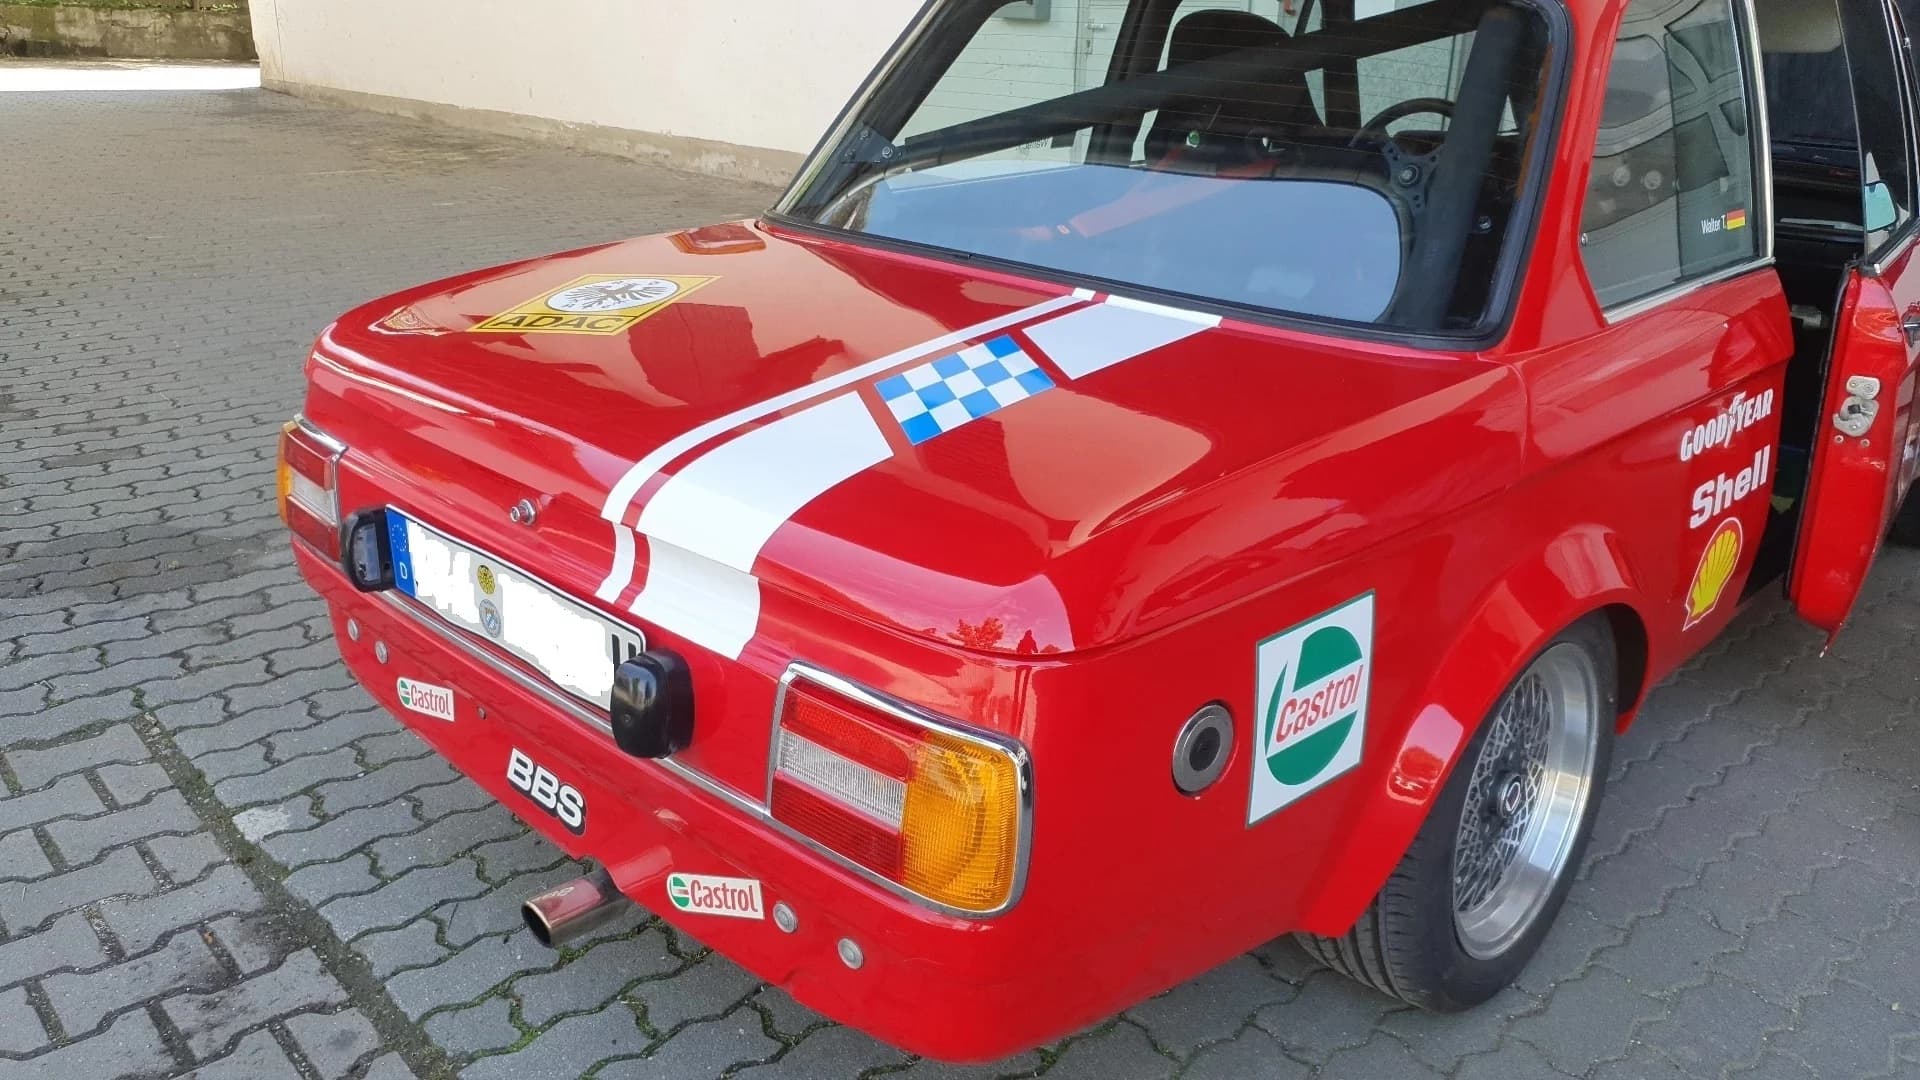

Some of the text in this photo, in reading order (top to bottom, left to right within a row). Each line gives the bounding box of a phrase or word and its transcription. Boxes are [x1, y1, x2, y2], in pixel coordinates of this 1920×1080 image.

[1701, 217, 1721, 235] Walter
[490, 315, 624, 330] ADAC
[1680, 388, 1774, 462] GOODYEAR
[1689, 444, 1771, 529] Shell
[399, 562, 408, 580] D
[411, 684, 451, 716] Castrol
[1275, 664, 1364, 743] Castrol
[506, 747, 585, 830] BBS
[690, 879, 759, 913] Castrol
